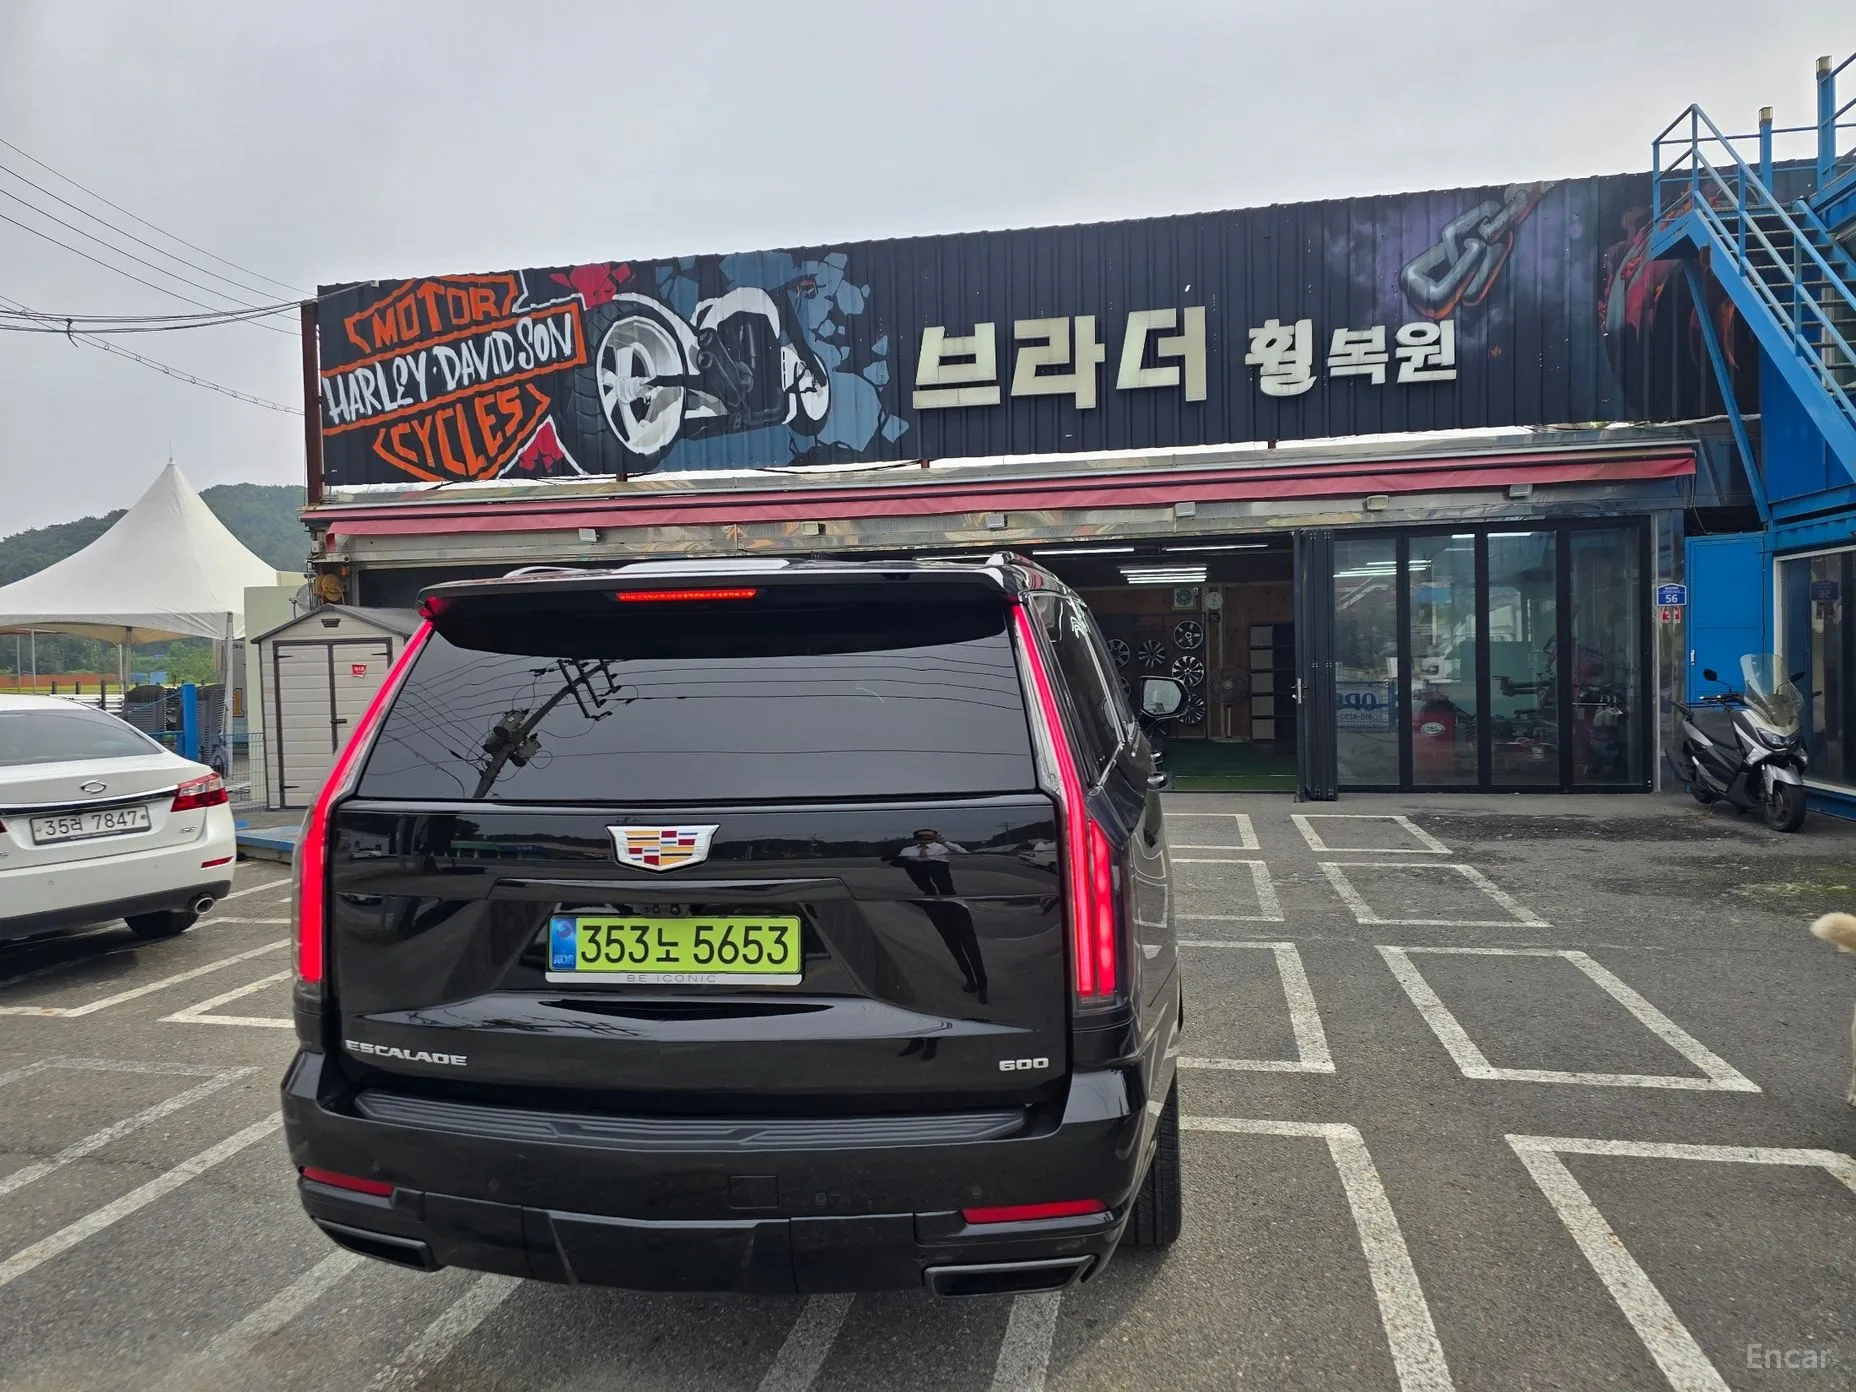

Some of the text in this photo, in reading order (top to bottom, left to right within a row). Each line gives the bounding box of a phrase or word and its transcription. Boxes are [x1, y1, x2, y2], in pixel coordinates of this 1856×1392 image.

[372, 281, 500, 348] MOTOR
[912, 306, 1208, 410] 브라더
[390, 386, 524, 477] CYCLES
[1665, 594, 1678, 603] 56
[91, 811, 137, 830] 7847
[581, 925, 788, 964] 353노 5653
[627, 974, 717, 983] BE ICONIC
[345, 1039, 467, 1066] ESCALADE
[999, 1057, 1049, 1071] 600
